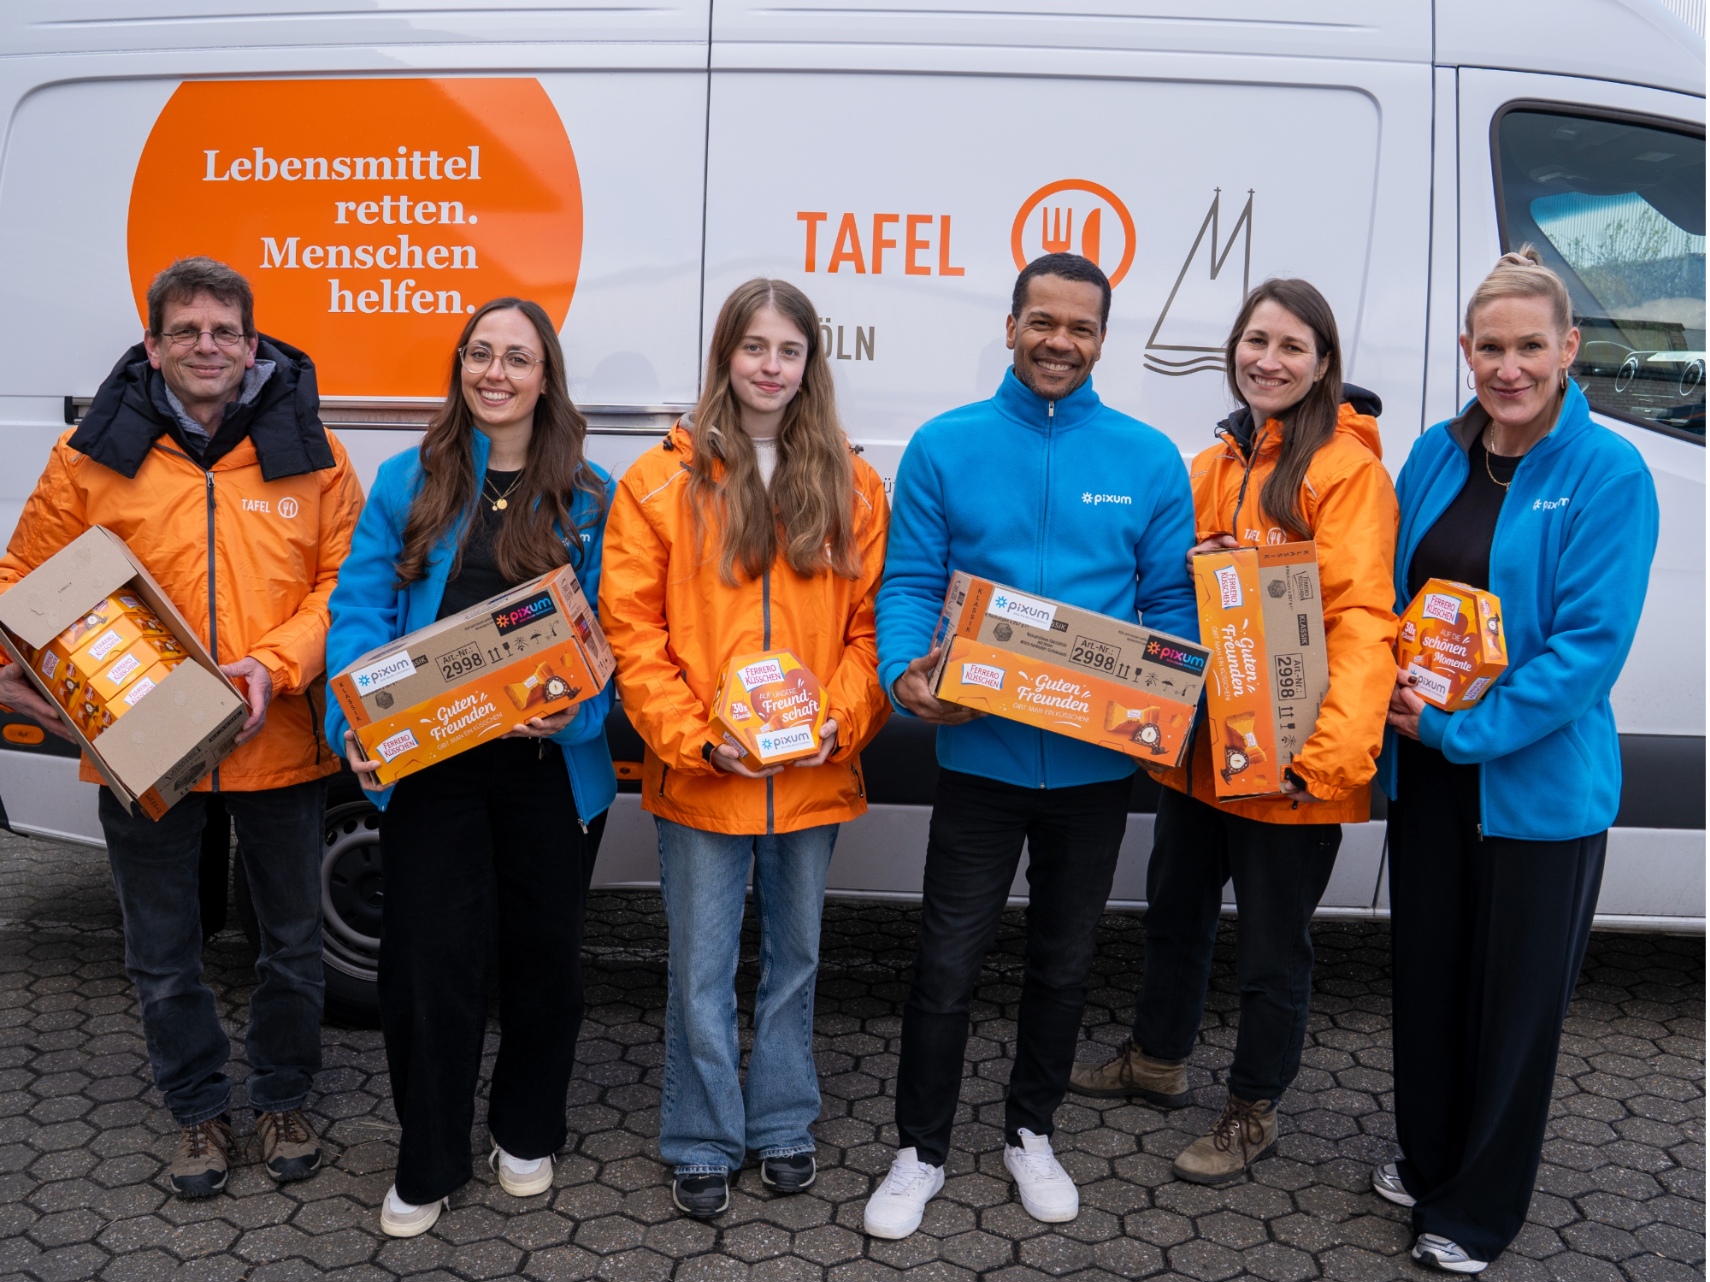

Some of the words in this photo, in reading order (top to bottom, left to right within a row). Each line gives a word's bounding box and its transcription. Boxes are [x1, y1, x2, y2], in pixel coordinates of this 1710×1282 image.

[203, 146, 481, 181] Lebensmittel
[335, 195, 478, 224] retten.
[260, 235, 478, 269] Menschen
[797, 212, 964, 276] TAFEL
[328, 280, 476, 313] helfen.
[818, 318, 875, 361] ÖLN
[242, 499, 270, 512] TAFEL
[1094, 494, 1132, 505] pixum
[1543, 497, 1570, 511] pixm
[510, 596, 552, 624] pixum
[966, 588, 983, 633] KLASSIK
[1007, 599, 1050, 621] pixum
[1072, 647, 1115, 672] 2998
[1080, 639, 1113, 655] Art.-Nr.:
[1160, 646, 1205, 669] pixum
[371, 658, 410, 684] pixum
[442, 653, 483, 680] 2998
[1277, 657, 1295, 699] 2998
[773, 688, 797, 698] UNSERE
[1035, 674, 1080, 696] Guten
[436, 693, 478, 726] Guten
[1017, 686, 1089, 713] Freunden
[430, 703, 496, 741] Freunden
